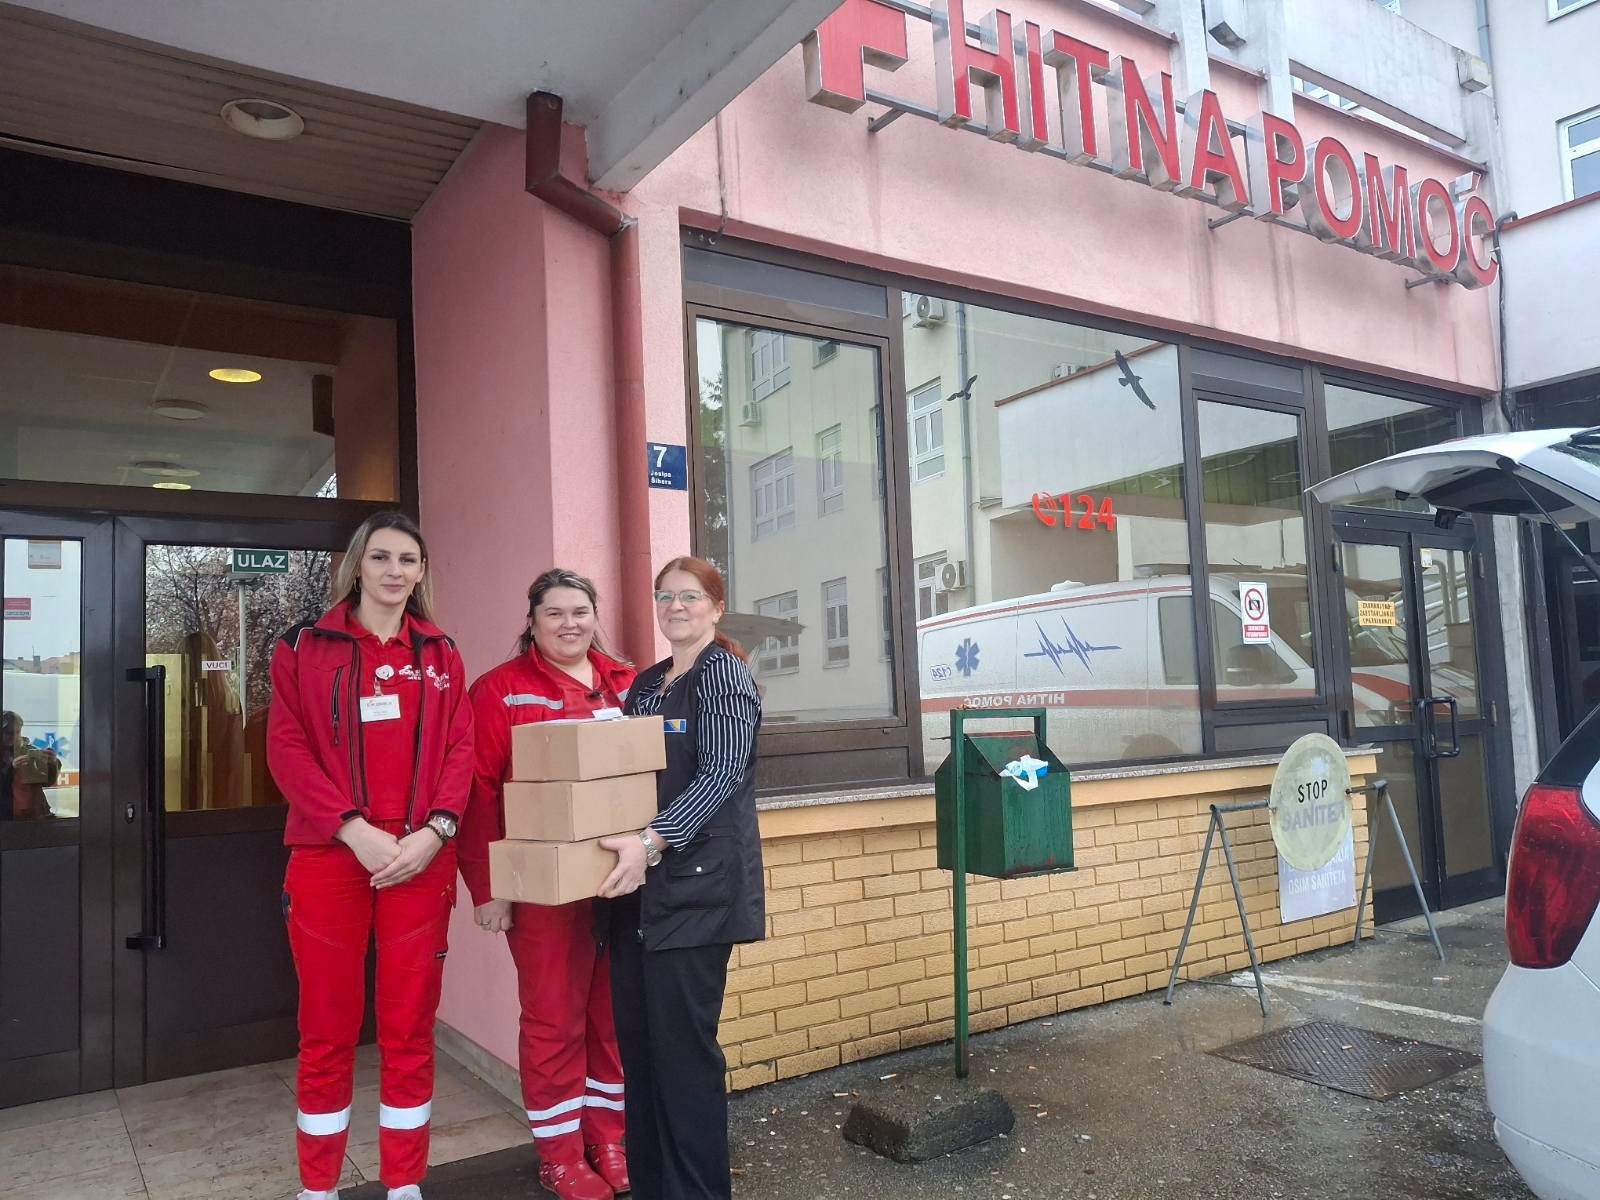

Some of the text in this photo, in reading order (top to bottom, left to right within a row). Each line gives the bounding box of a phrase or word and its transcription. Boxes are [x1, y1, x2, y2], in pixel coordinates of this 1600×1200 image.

[938, 0, 1500, 288] HITNA POMOĆ
[653, 446, 667, 467] 7
[1058, 494, 1116, 531] 124
[237, 554, 286, 568] ULAZ
[1298, 780, 1328, 803] STOP
[1281, 802, 1346, 832] SANITET
[1288, 870, 1346, 895] OSIM SANITETA
